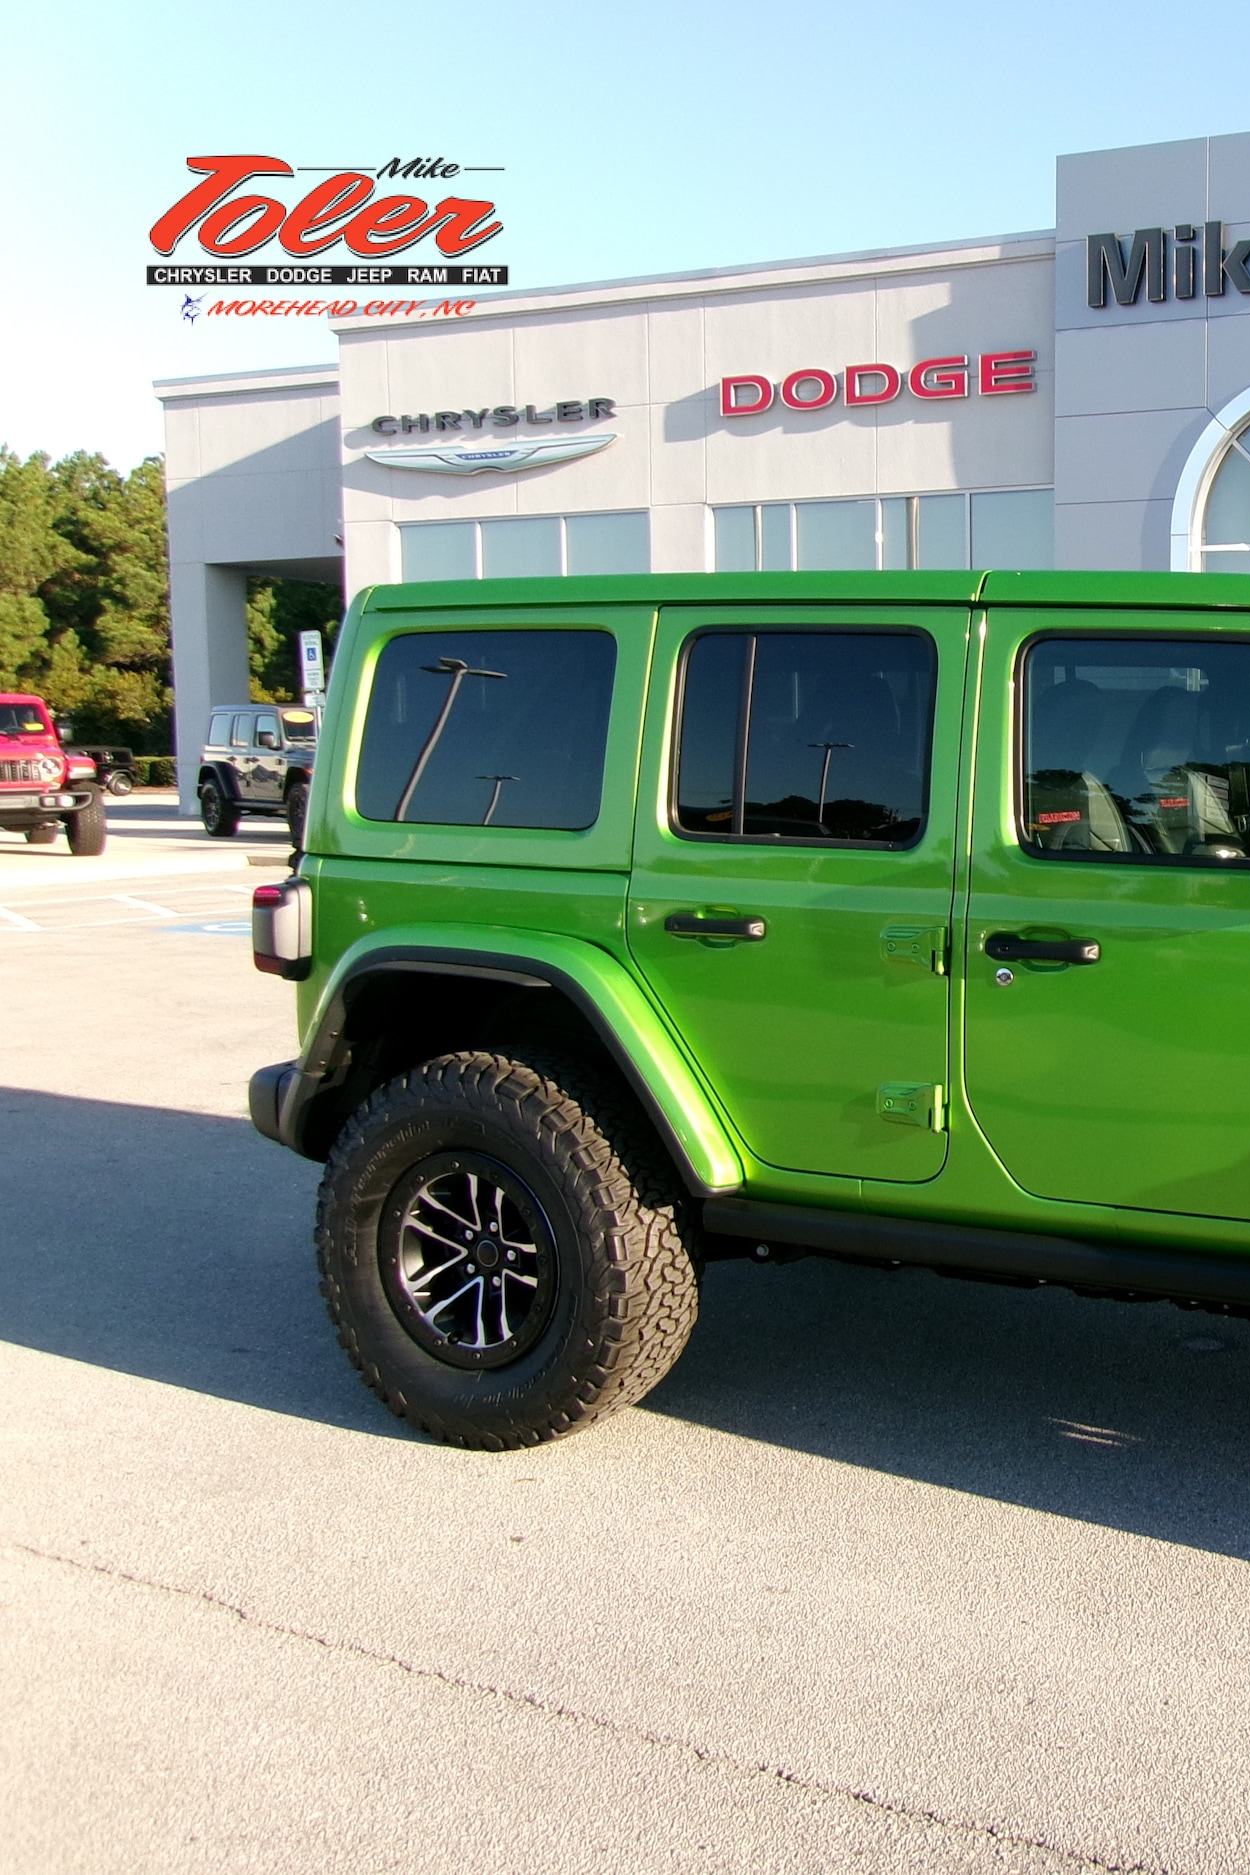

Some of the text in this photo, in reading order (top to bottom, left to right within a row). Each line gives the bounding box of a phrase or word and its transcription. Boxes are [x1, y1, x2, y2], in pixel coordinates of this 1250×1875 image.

[719, 350, 1038, 417] DODGE
[371, 397, 618, 437] CHRYSLER
[461, 451, 512, 460] CHRYSLER
